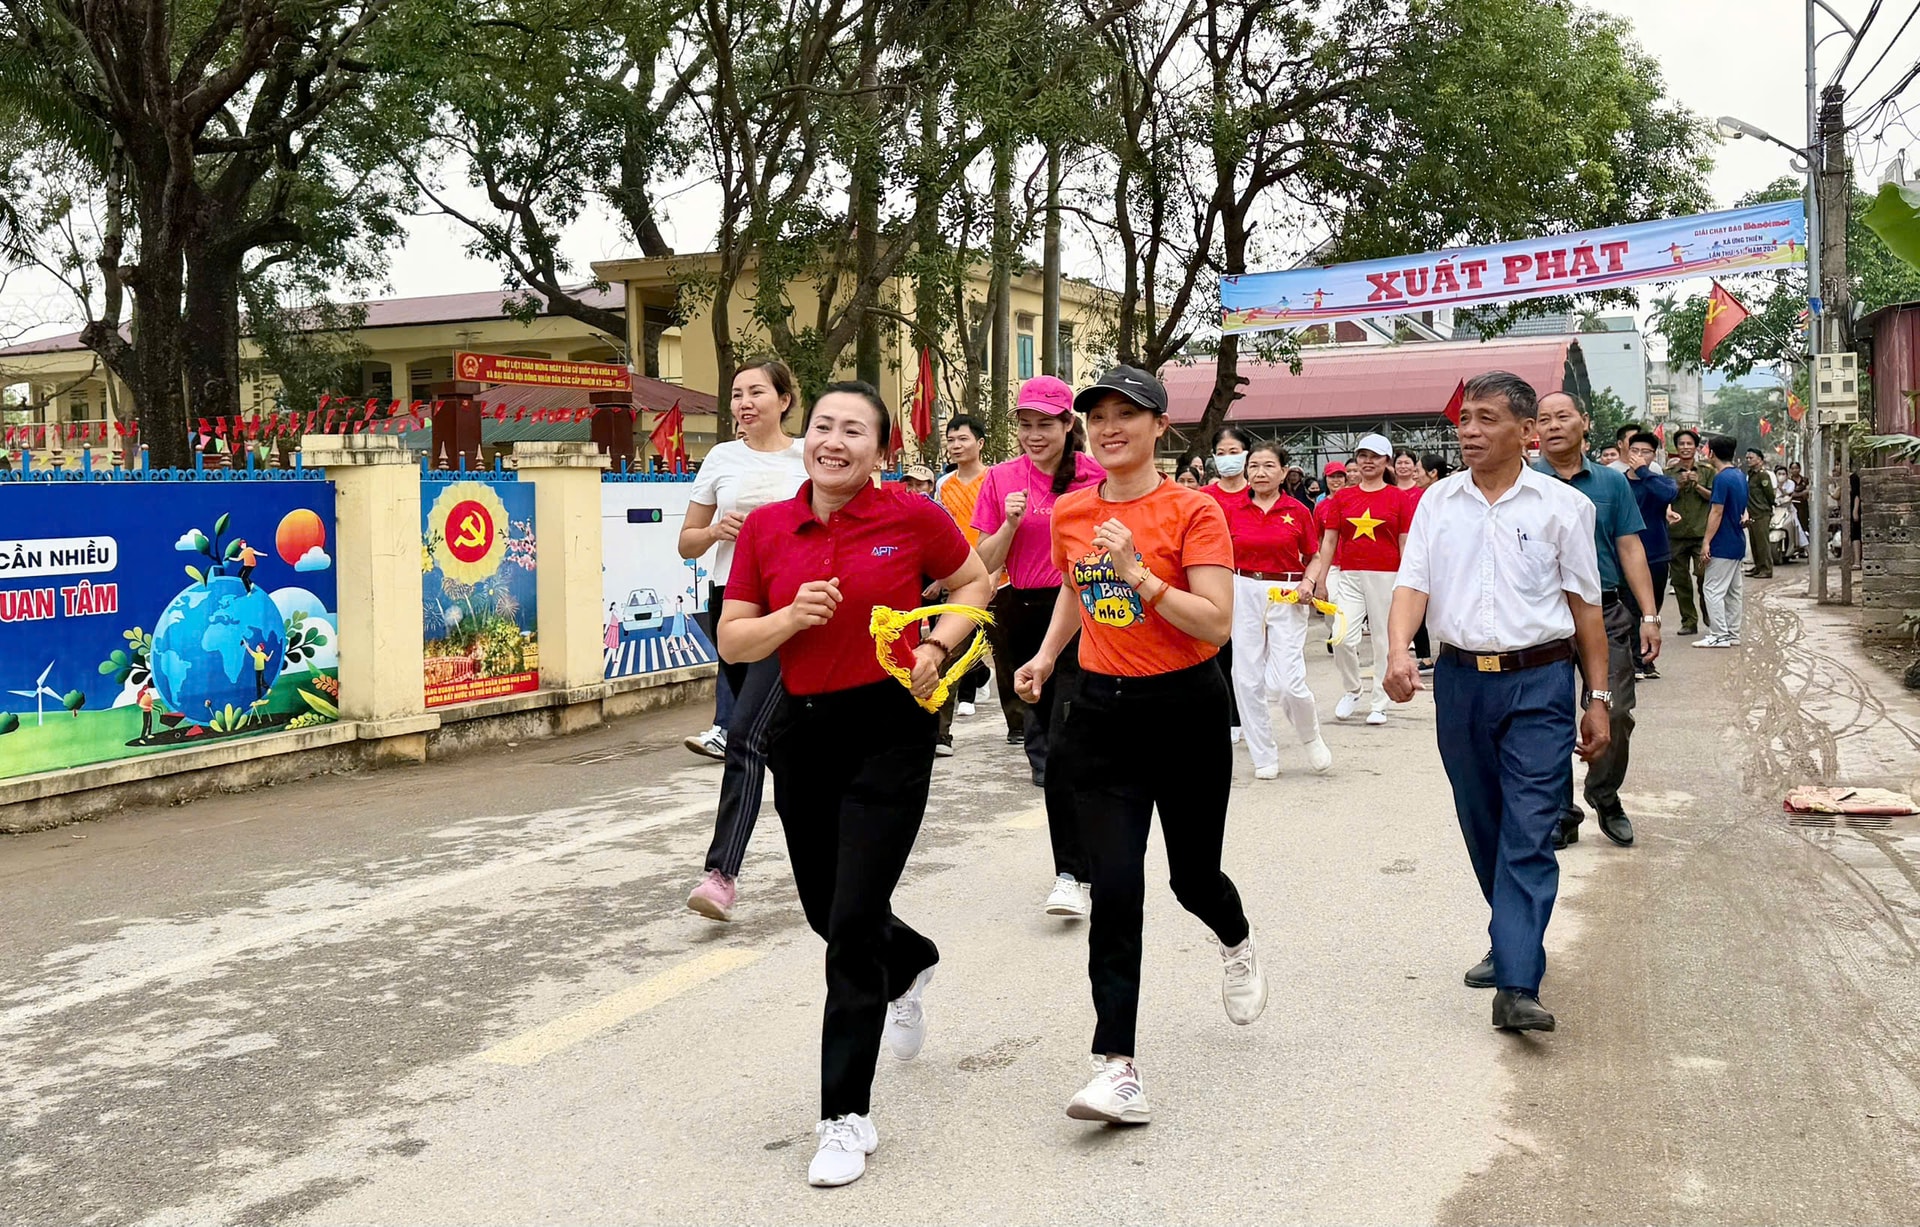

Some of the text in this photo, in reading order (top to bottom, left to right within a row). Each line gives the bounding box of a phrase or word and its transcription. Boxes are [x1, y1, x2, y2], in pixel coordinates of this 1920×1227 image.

[1366, 239, 1628, 302] XUẤT PHÁT
[0, 540, 109, 570] CẦN NHIỀU
[61, 580, 118, 617] TÂM
[1098, 605, 1126, 619] nhé
